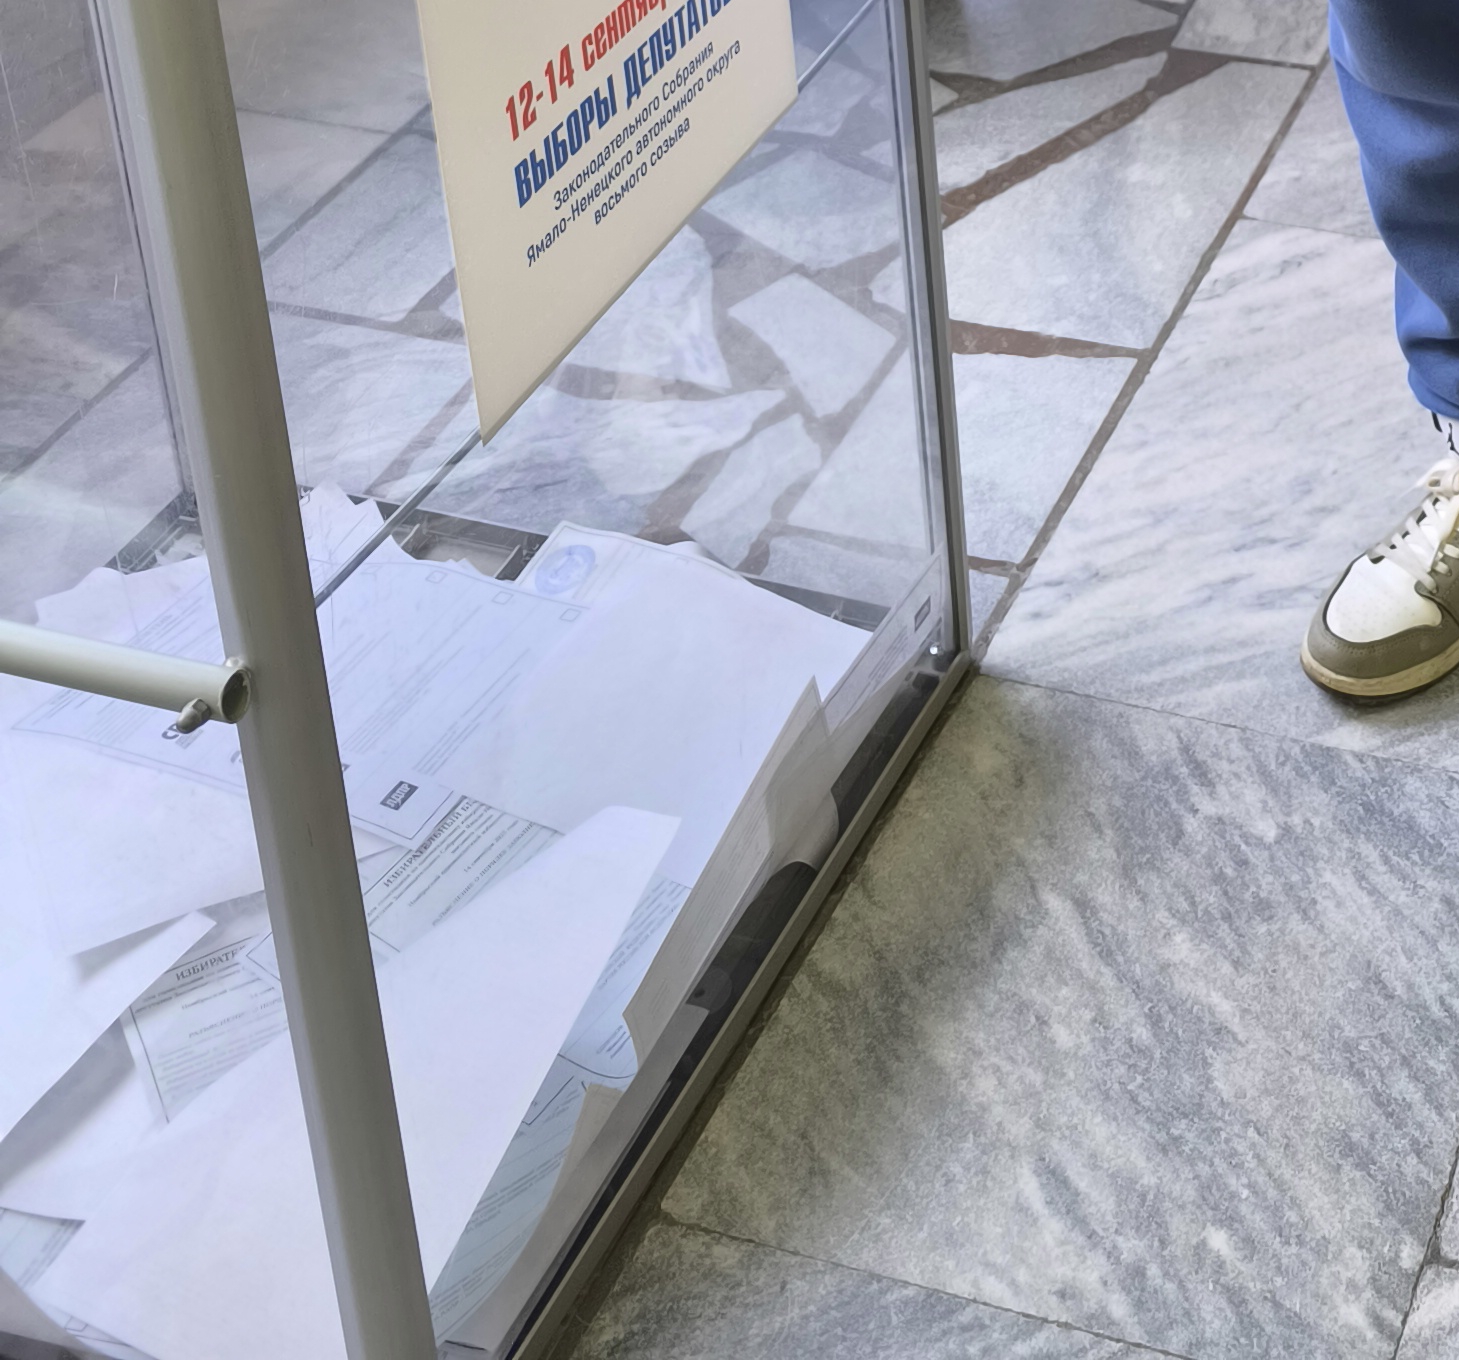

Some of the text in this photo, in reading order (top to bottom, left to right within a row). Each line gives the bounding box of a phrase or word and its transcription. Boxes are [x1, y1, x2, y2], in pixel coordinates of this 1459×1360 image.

[506, 44, 575, 141] 12-14
[514, 74, 618, 208] ВЫБОРЫ
[527, 40, 740, 267] Ямало-Ненецкого автономного округа
[553, 42, 714, 211] Законодательного Собрания
[595, 117, 691, 225] восьмого созыва
